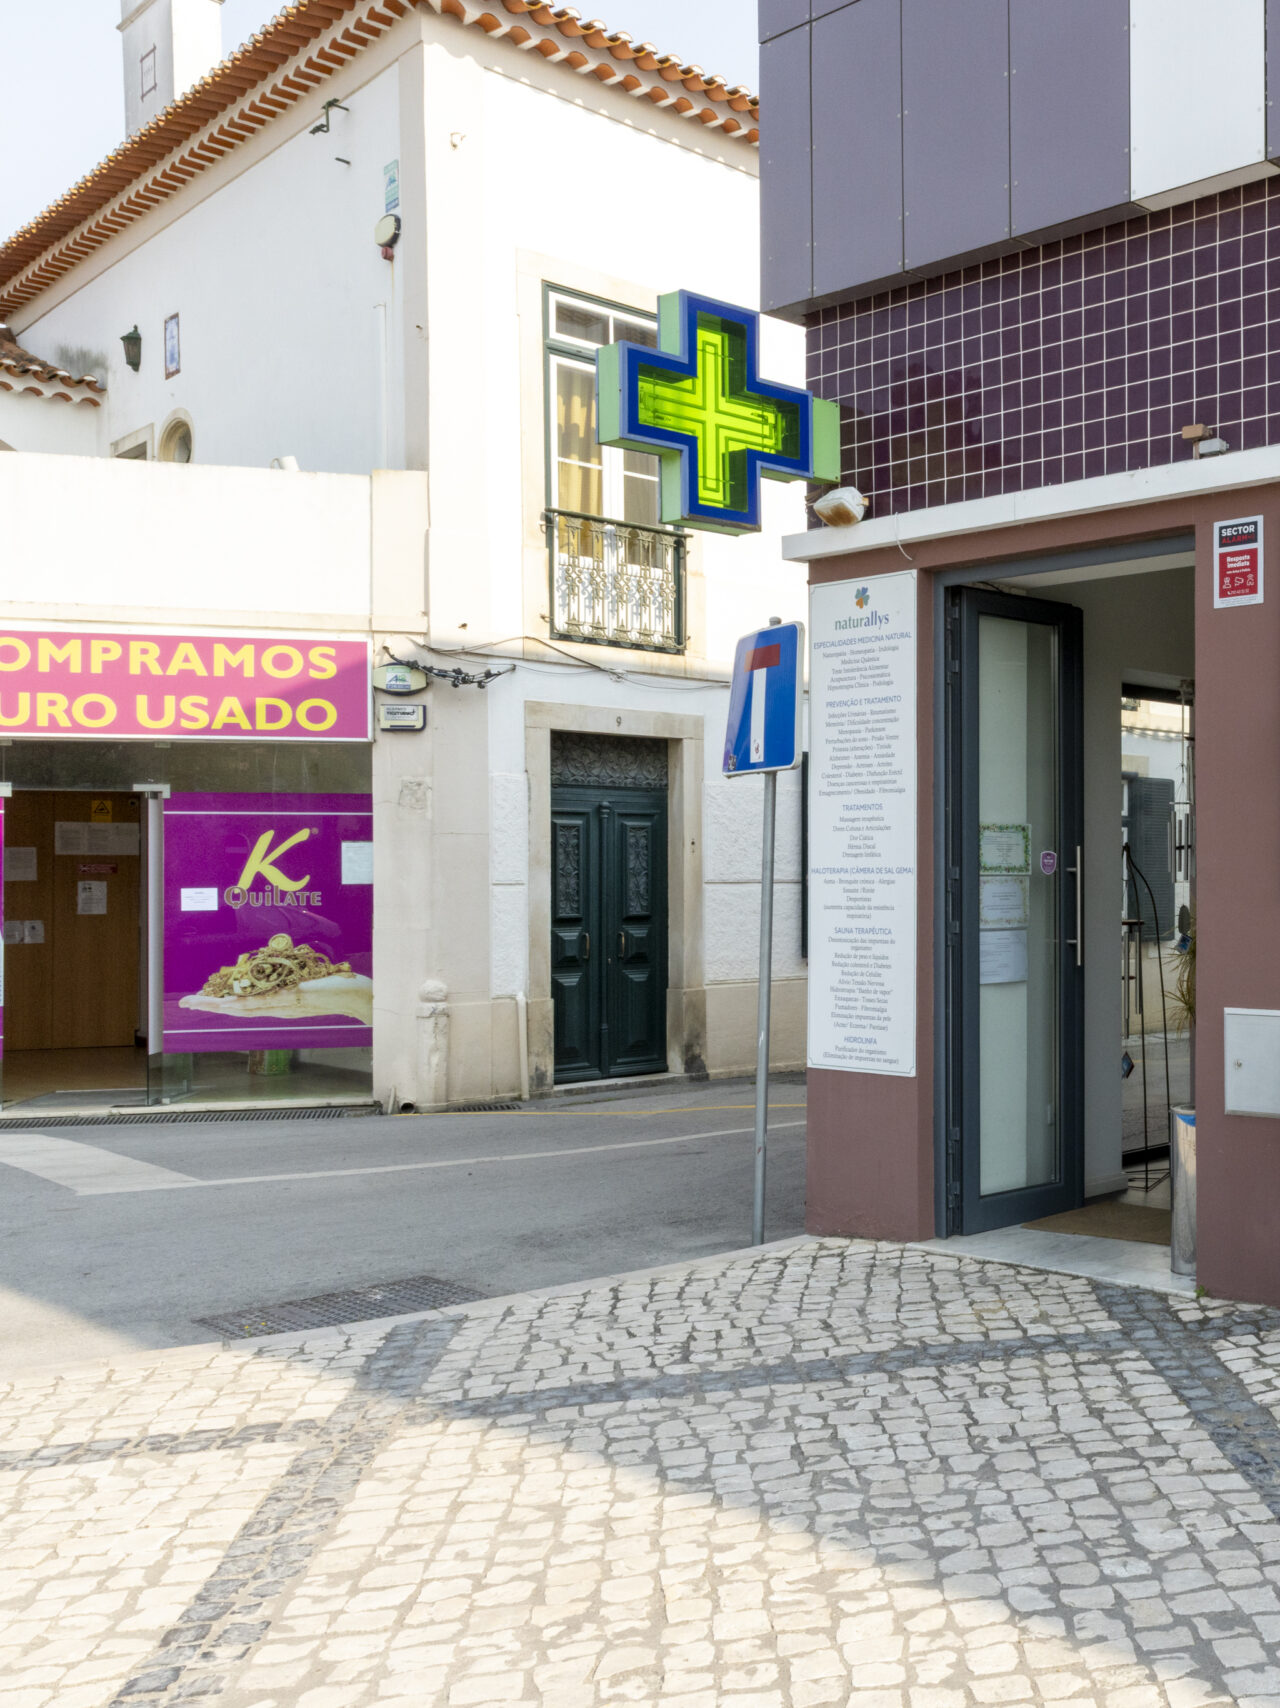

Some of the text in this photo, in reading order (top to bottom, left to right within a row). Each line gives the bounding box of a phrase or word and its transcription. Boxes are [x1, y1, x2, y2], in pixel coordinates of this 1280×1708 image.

[1222, 525, 1255, 536] SECTOR
[1222, 534, 1248, 544] ALARM
[835, 610, 889, 630] naturallys
[814, 632, 912, 649] ESPECIALIDADES MEDICINA NATURAL
[826, 698, 858, 708] PREVENÇÃO
[864, 696, 901, 705] TRATAMENTO
[135, 694, 338, 732] USADO
[843, 803, 883, 811] TRATAMENTOS
[234, 828, 311, 894] K
